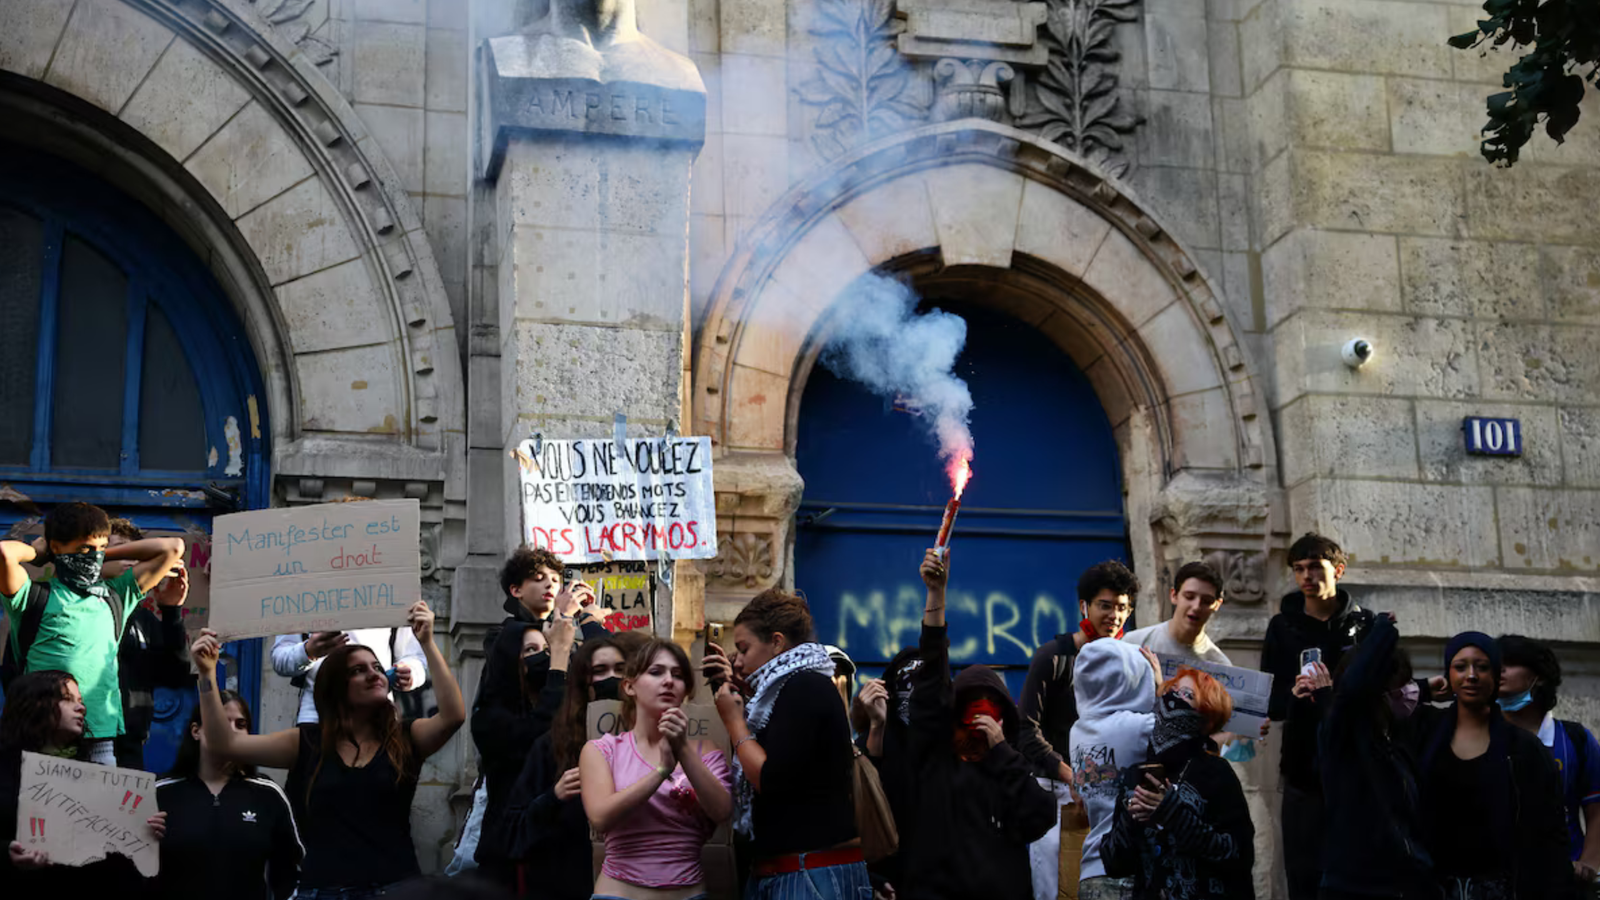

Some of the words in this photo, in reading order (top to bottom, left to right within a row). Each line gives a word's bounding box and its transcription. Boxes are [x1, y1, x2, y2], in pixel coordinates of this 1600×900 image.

[1472, 419, 1516, 451] 101
[529, 441, 587, 481] VOUS
[593, 441, 618, 477] NE
[624, 440, 702, 475] VOULEZ
[524, 482, 553, 504] PAS
[612, 482, 637, 500] NOS
[641, 481, 687, 498] MOTS
[558, 502, 605, 525] VOUS
[227, 519, 354, 556] Manifester
[365, 515, 401, 536] est
[532, 526, 575, 555] DES
[272, 560, 308, 577] un
[330, 543, 383, 570] droit
[261, 583, 406, 618] FONDAMENTAL
[621, 591, 646, 610] LA
